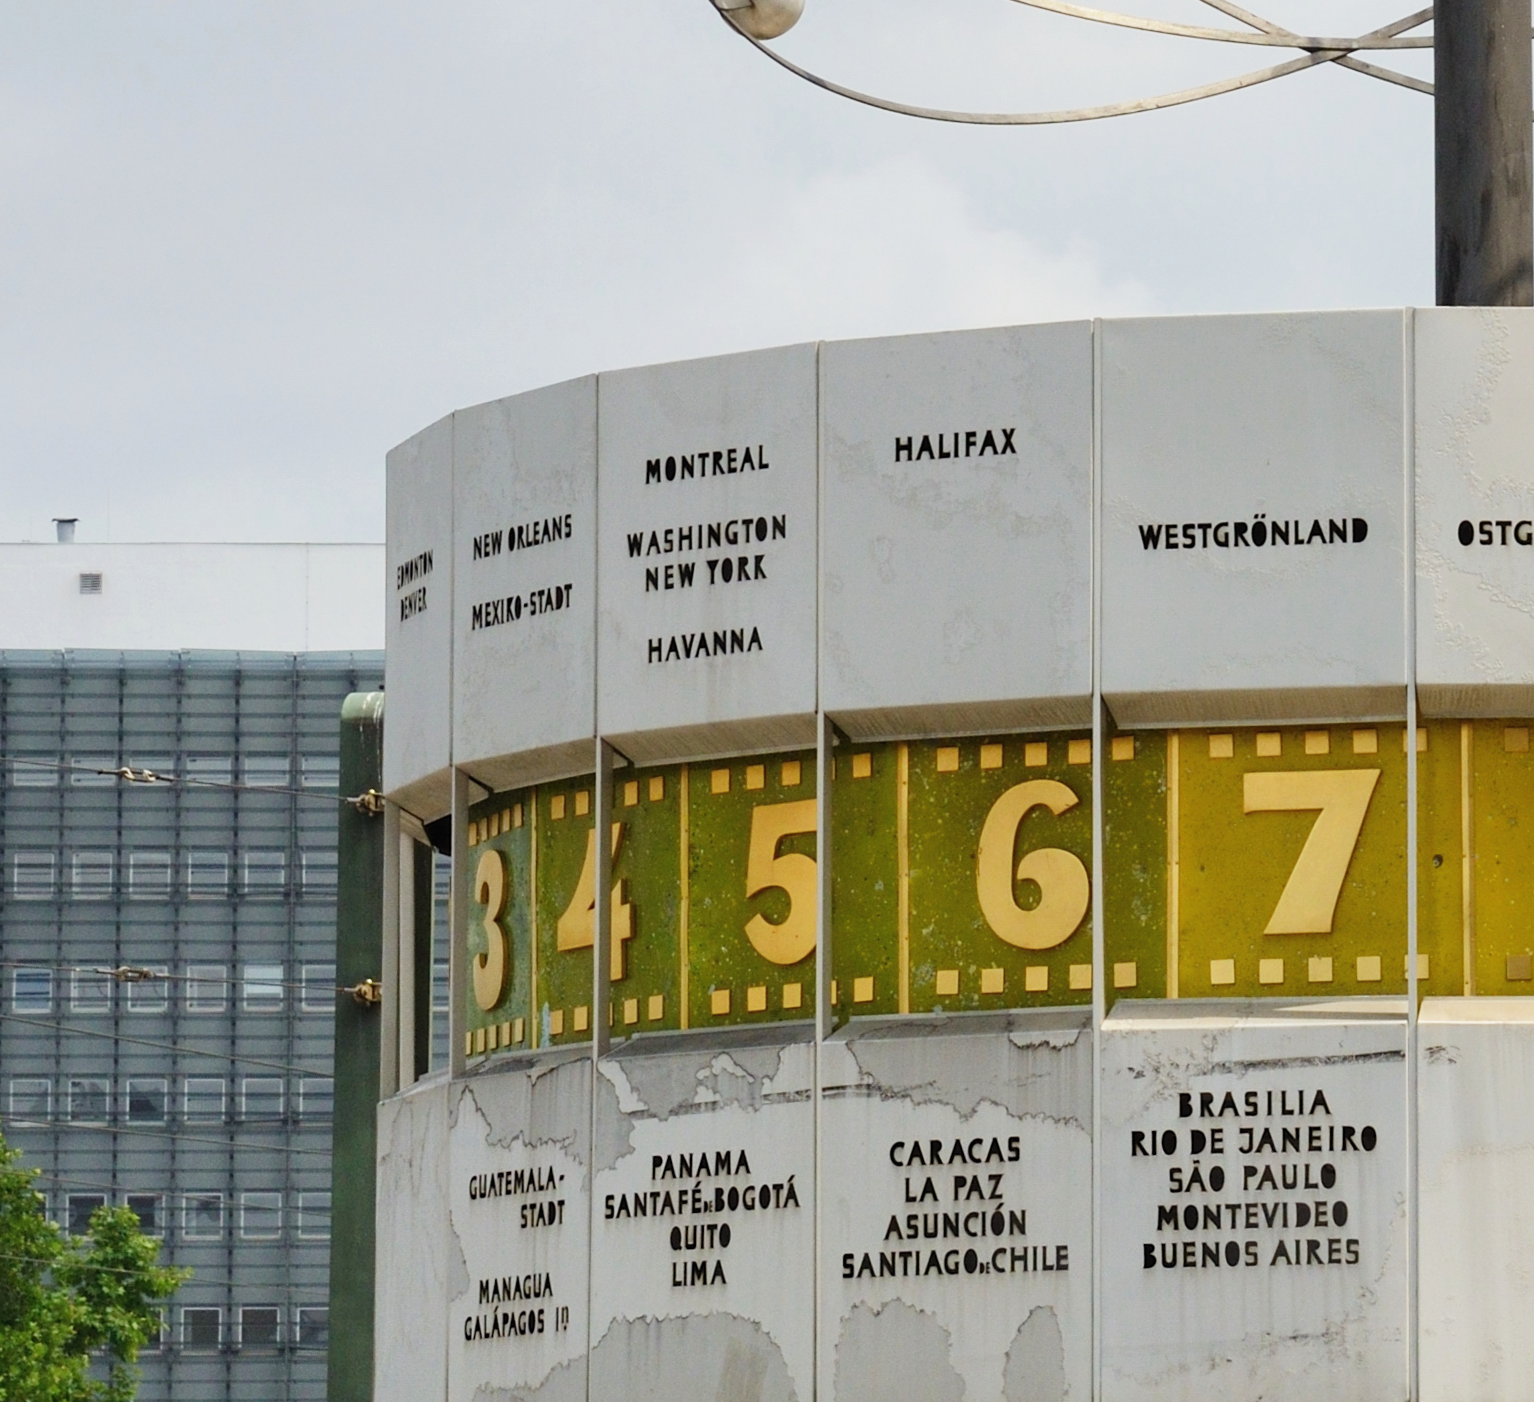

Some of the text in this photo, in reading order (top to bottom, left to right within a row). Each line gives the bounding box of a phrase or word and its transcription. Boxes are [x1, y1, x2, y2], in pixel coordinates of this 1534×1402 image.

[895, 428, 1017, 463] HALIFAX
[645, 444, 770, 485] MONTREAL
[473, 513, 572, 561] NEW ORLEANS
[626, 514, 786, 558] WASHINGTON
[1138, 513, 1369, 550] WESTGRÖNLAND
[397, 548, 434, 590] EDMONTON
[645, 554, 767, 592] NEW YORK
[400, 586, 428, 622] DENVER
[471, 583, 573, 631] MEXIKO-STADT
[648, 626, 763, 664] HAVANNA
[977, 779, 1090, 950] 6
[1243, 768, 1382, 935] 7
[744, 799, 817, 965] 5
[557, 821, 635, 982] 4
[473, 850, 509, 1011] 3
[1178, 1089, 1332, 1118] BRASILIA
[889, 1136, 1021, 1167] CARACAS
[1131, 1125, 1377, 1157] RIO DE JANEIRO
[469, 1165, 565, 1201] GUATEMALA-
[651, 1149, 751, 1181] PANAMA
[1169, 1159, 1337, 1194] SÃO PAULO
[904, 1173, 1003, 1203] LA PAZ
[520, 1199, 565, 1229] STADT
[883, 1202, 1026, 1241] ASUNCIÓN
[1156, 1200, 1348, 1231] MONTEVIDEO
[669, 1223, 731, 1251] QUITO
[1143, 1238, 1360, 1270] BUENOS AIRES
[478, 1272, 553, 1305] MANAGUA
[672, 1259, 727, 1287] LIMA
[464, 1305, 545, 1342] GALÁPAGOS
